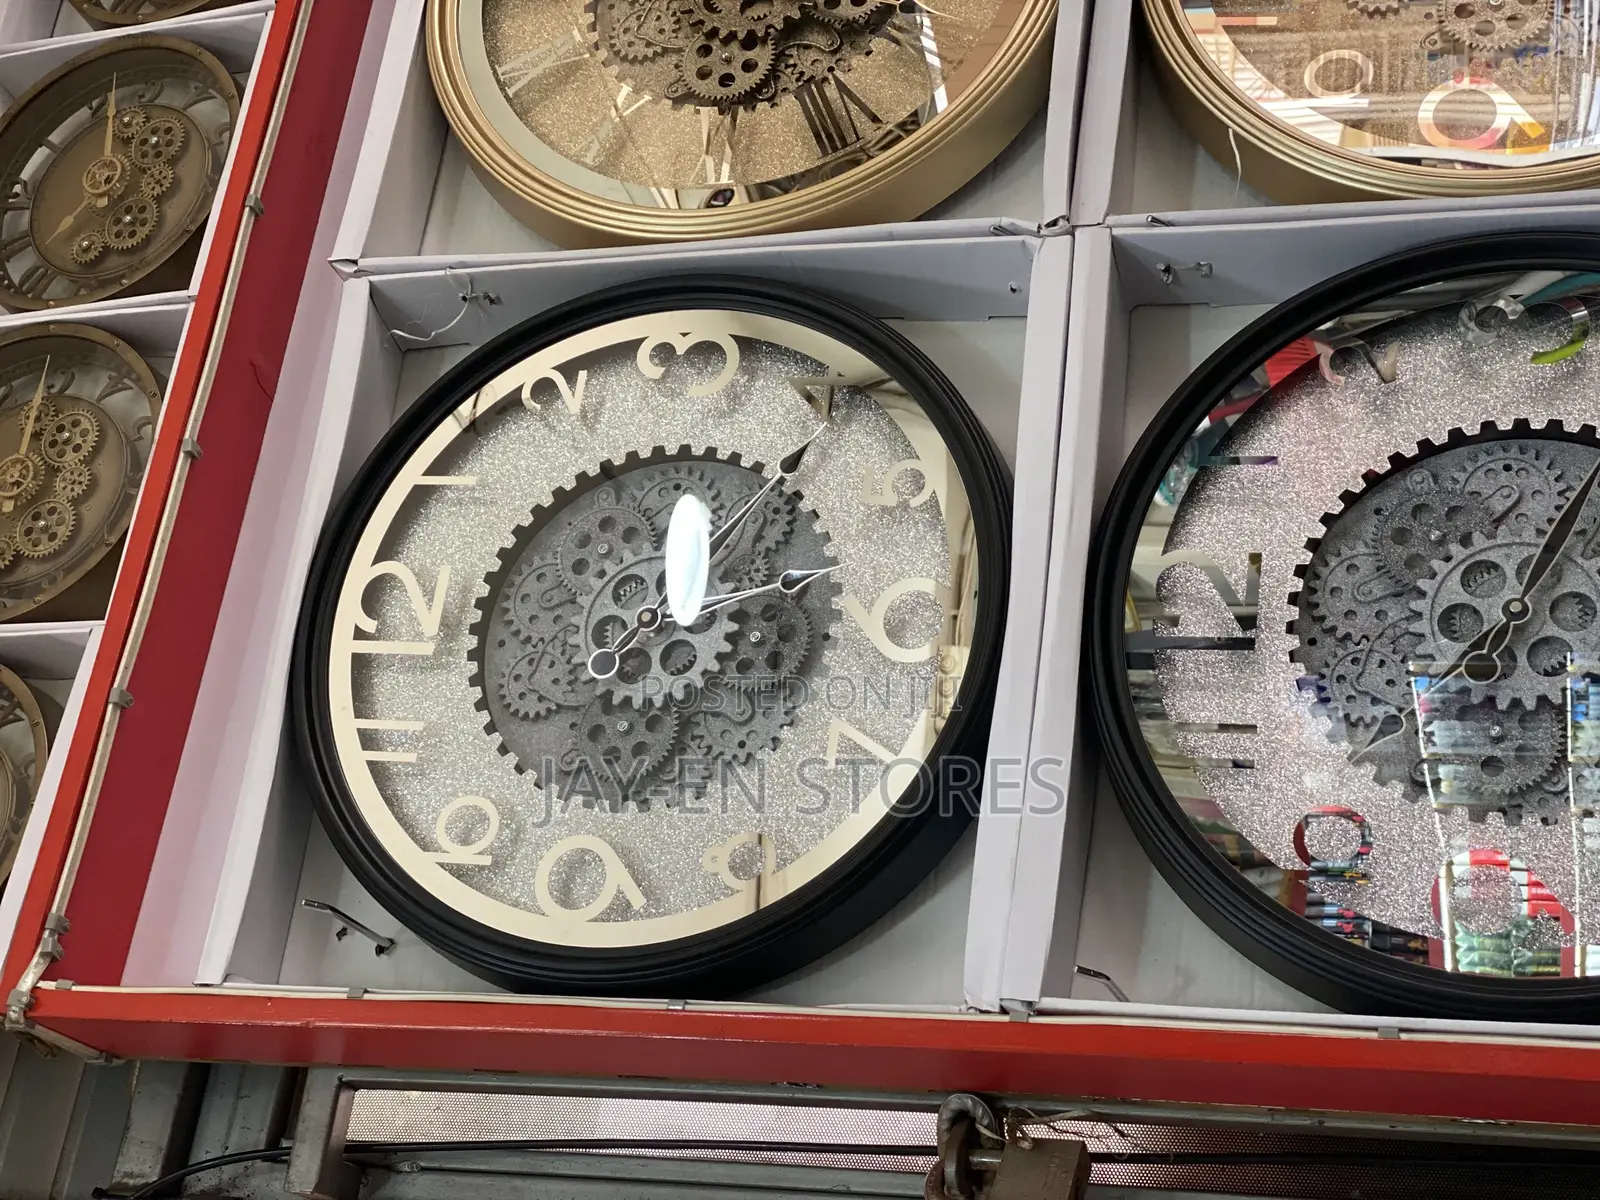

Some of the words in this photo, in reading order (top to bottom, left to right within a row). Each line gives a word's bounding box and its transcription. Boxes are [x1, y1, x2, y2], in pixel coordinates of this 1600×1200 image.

[520, 366, 589, 416] 2
[636, 330, 740, 398] 3
[860, 458, 937, 508] 5
[350, 559, 451, 656] 12
[836, 576, 946, 664] 6
[352, 717, 425, 764] 11
[424, 795, 501, 866] 10
[534, 834, 648, 923] 9
